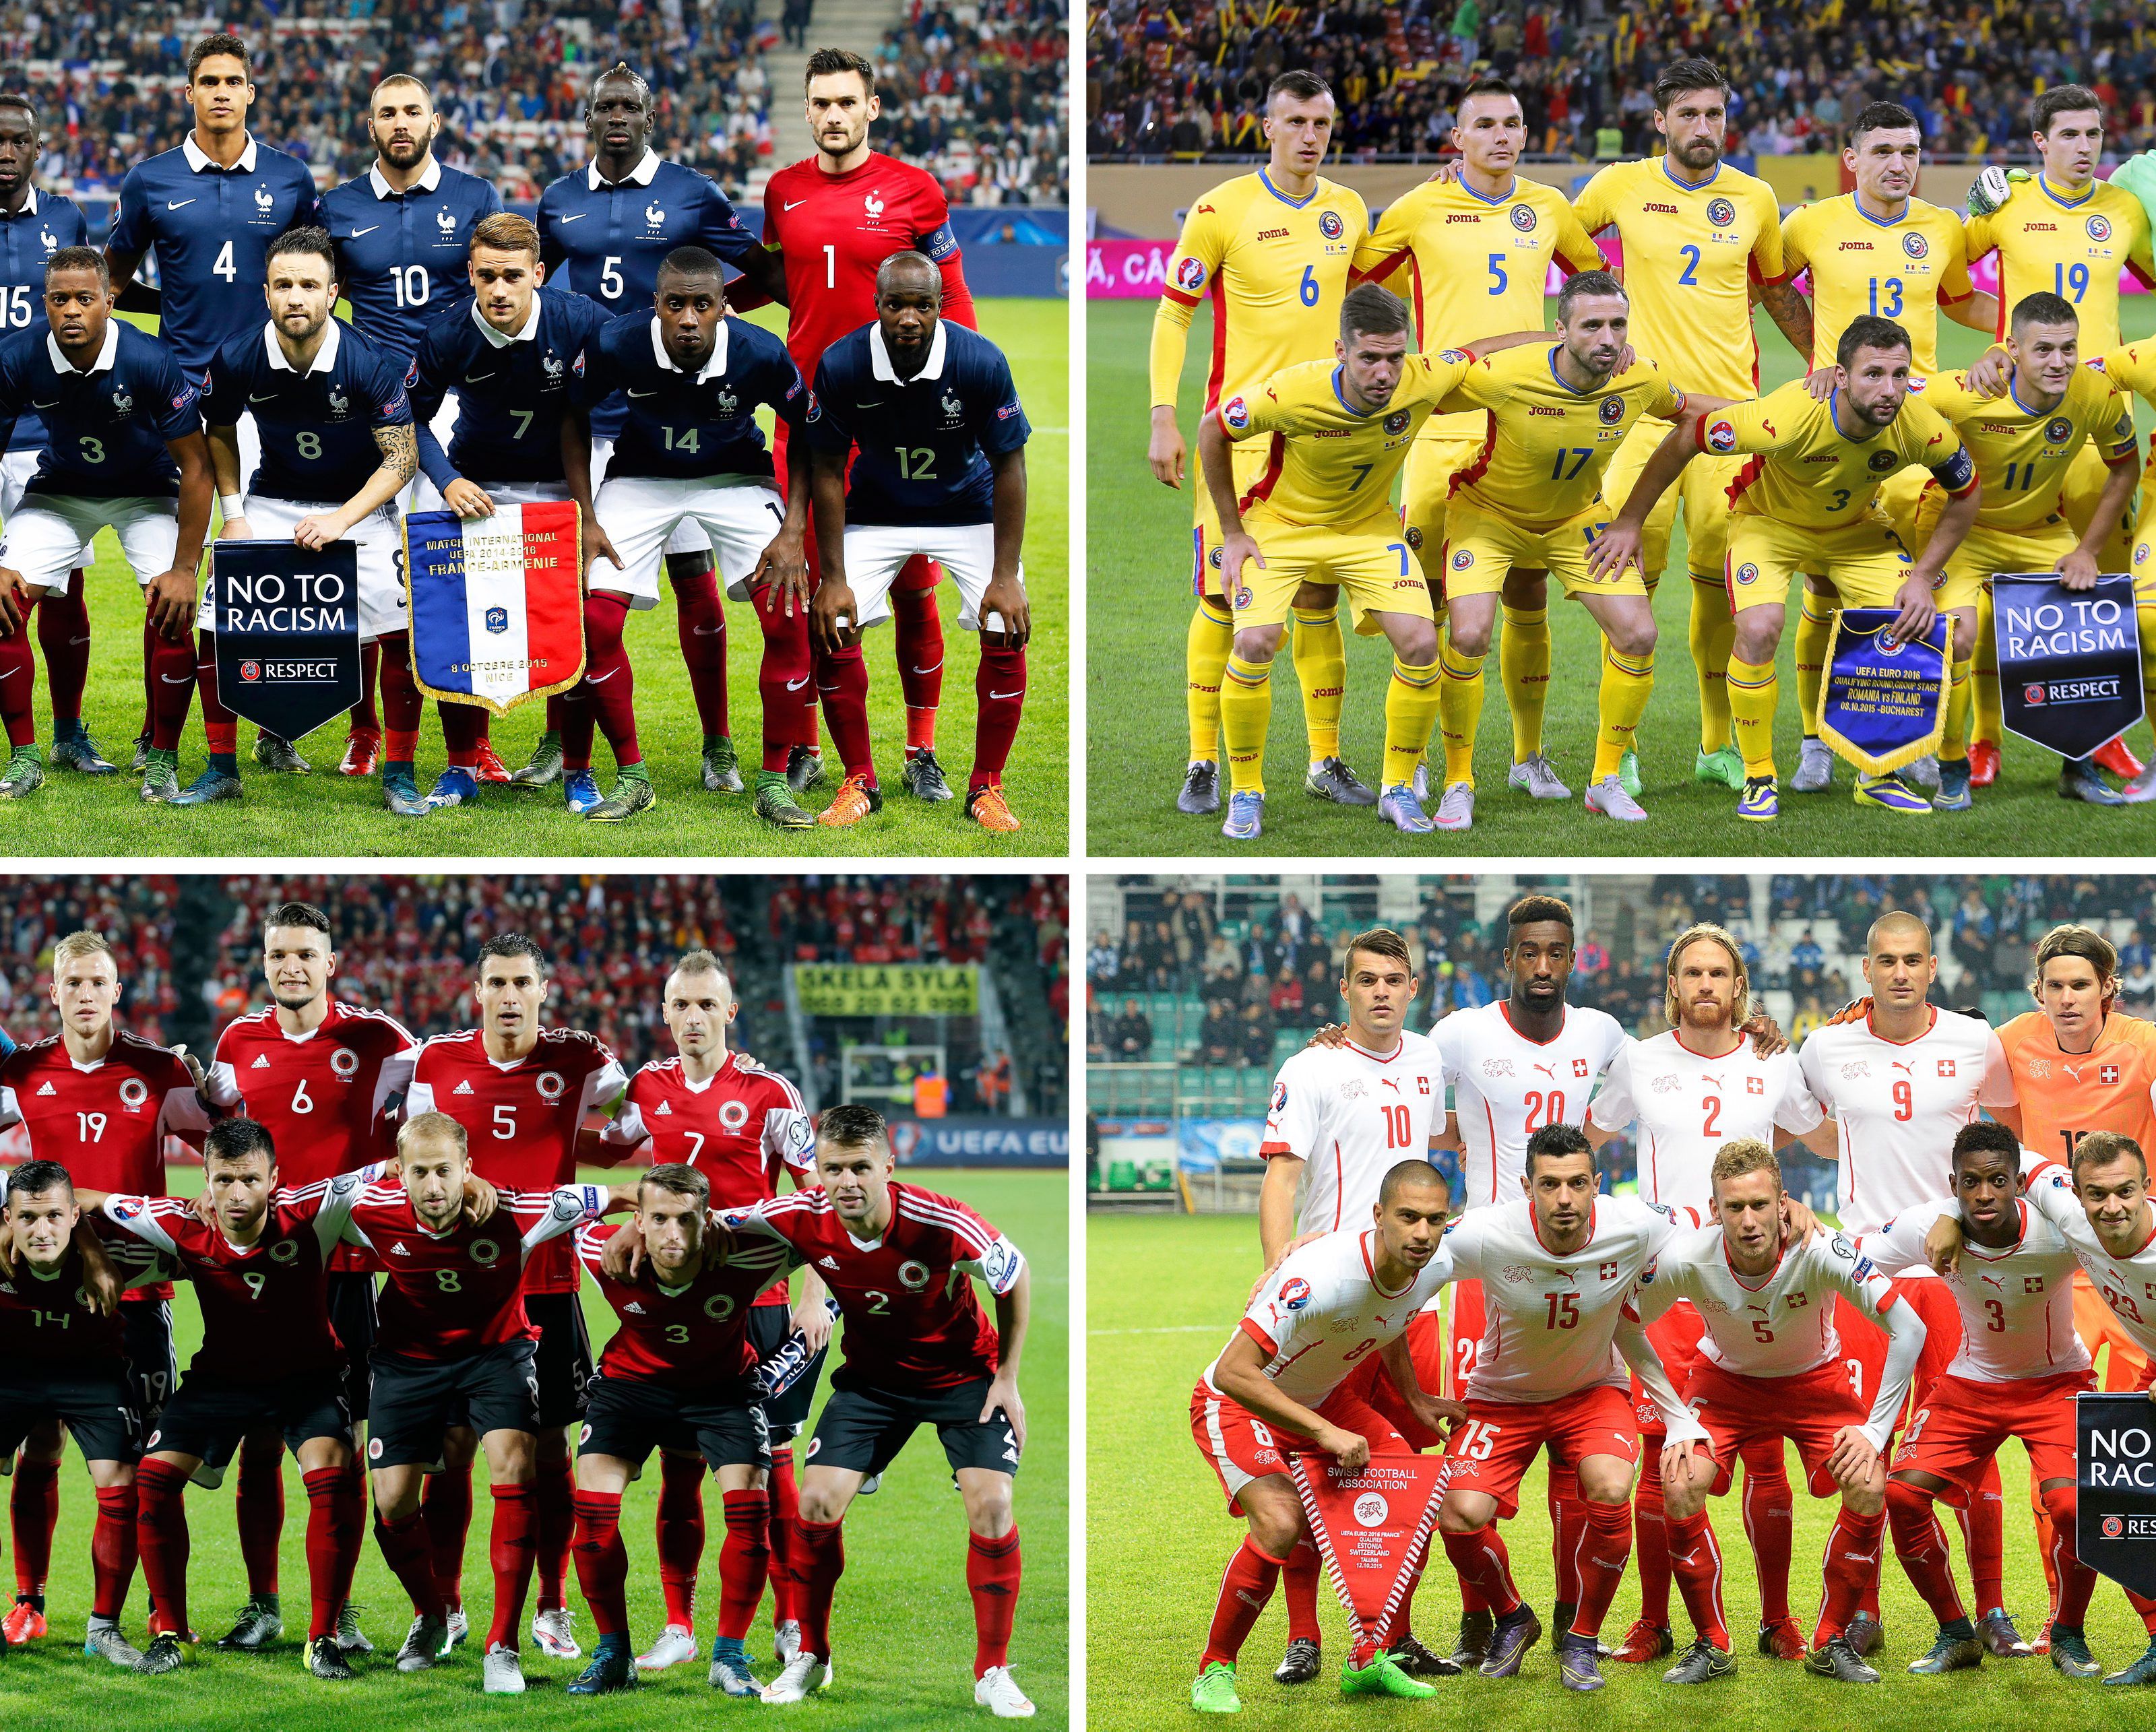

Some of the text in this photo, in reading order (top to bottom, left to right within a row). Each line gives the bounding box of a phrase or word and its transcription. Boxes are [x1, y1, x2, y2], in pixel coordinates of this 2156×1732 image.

[213, 240, 236, 283] 4
[823, 245, 835, 288] 1
[1123, 247, 1173, 284] CÂ
[1489, 254, 1507, 296] 5
[1678, 245, 1701, 286] 2
[389, 265, 430, 308] 10
[600, 256, 624, 299] 5
[1300, 265, 1319, 307] 6
[2055, 263, 2089, 304] 19
[0, 286, 32, 328] 15
[1869, 278, 1903, 318] 13
[509, 410, 534, 439] 7
[662, 426, 701, 453] 14
[80, 437, 105, 463] 3
[296, 431, 322, 459] 8
[895, 447, 937, 480] 12
[1347, 463, 1374, 491] 7
[1551, 448, 1594, 480] 17
[2004, 463, 2035, 490] 11
[1825, 489, 1851, 512] 3
[426, 532, 558, 550] MATCH INTERNATIONAL
[449, 546, 536, 559] UEFA 2014-2016
[1884, 530, 1913, 563] 3
[429, 557, 559, 576] FRANCE-ARMENIE
[1386, 544, 1409, 577] 7
[1898, 569, 1913, 577] Jo
[227, 573, 344, 604] NO TO
[228, 606, 346, 632] RACISM
[2007, 599, 2122, 633] NO TO
[2008, 627, 2126, 658] RACISM
[265, 664, 337, 678] RESPECT
[451, 659, 547, 673] 8 OCTOBRE 2015
[486, 673, 513, 682] NICE
[1856, 666, 1921, 680] UEFA EURO 2016
[1835, 676, 1872, 687] QUALIFYING
[1917, 682, 1939, 692] STAGE
[1847, 688, 1922, 705] ROMANIA vs FINLAND
[2049, 680, 2120, 700] RESPECT
[1840, 701, 1876, 713] 08.10.2015
[291, 1079, 314, 1114] 6
[1893, 1081, 1912, 1121] 9
[76, 1112, 106, 1143] 19
[493, 1105, 517, 1139] 5
[1381, 1105, 1412, 1148] 10
[1523, 1091, 1565, 1134] 20
[1703, 1096, 1721, 1136] 2
[684, 1131, 705, 1166] 7
[936, 1129, 1069, 1155] UEFA EU
[819, 1260, 840, 1270] adidas
[243, 1272, 265, 1300] 9
[436, 1269, 462, 1292] 8
[865, 1291, 891, 1315] 2
[1544, 1293, 1581, 1330] 15
[1984, 1299, 2006, 1333] 3
[2103, 1287, 2145, 1324] 23
[32, 1310, 69, 1329] 14
[665, 1324, 690, 1344] 3
[1751, 1320, 1775, 1343] 5
[1342, 1338, 1376, 1361] 8
[140, 1370, 168, 1403] 19
[572, 1357, 585, 1392] 5
[749, 1407, 769, 1436] 3
[1250, 1419, 1275, 1447] 8
[1904, 1409, 1931, 1442] 3
[1458, 1418, 1502, 1461] 15
[2091, 1428, 2151, 1458] NO
[1328, 1467, 1418, 1479] SWISS FOOTBALL
[1337, 1479, 1407, 1489] ASSOCIATION
